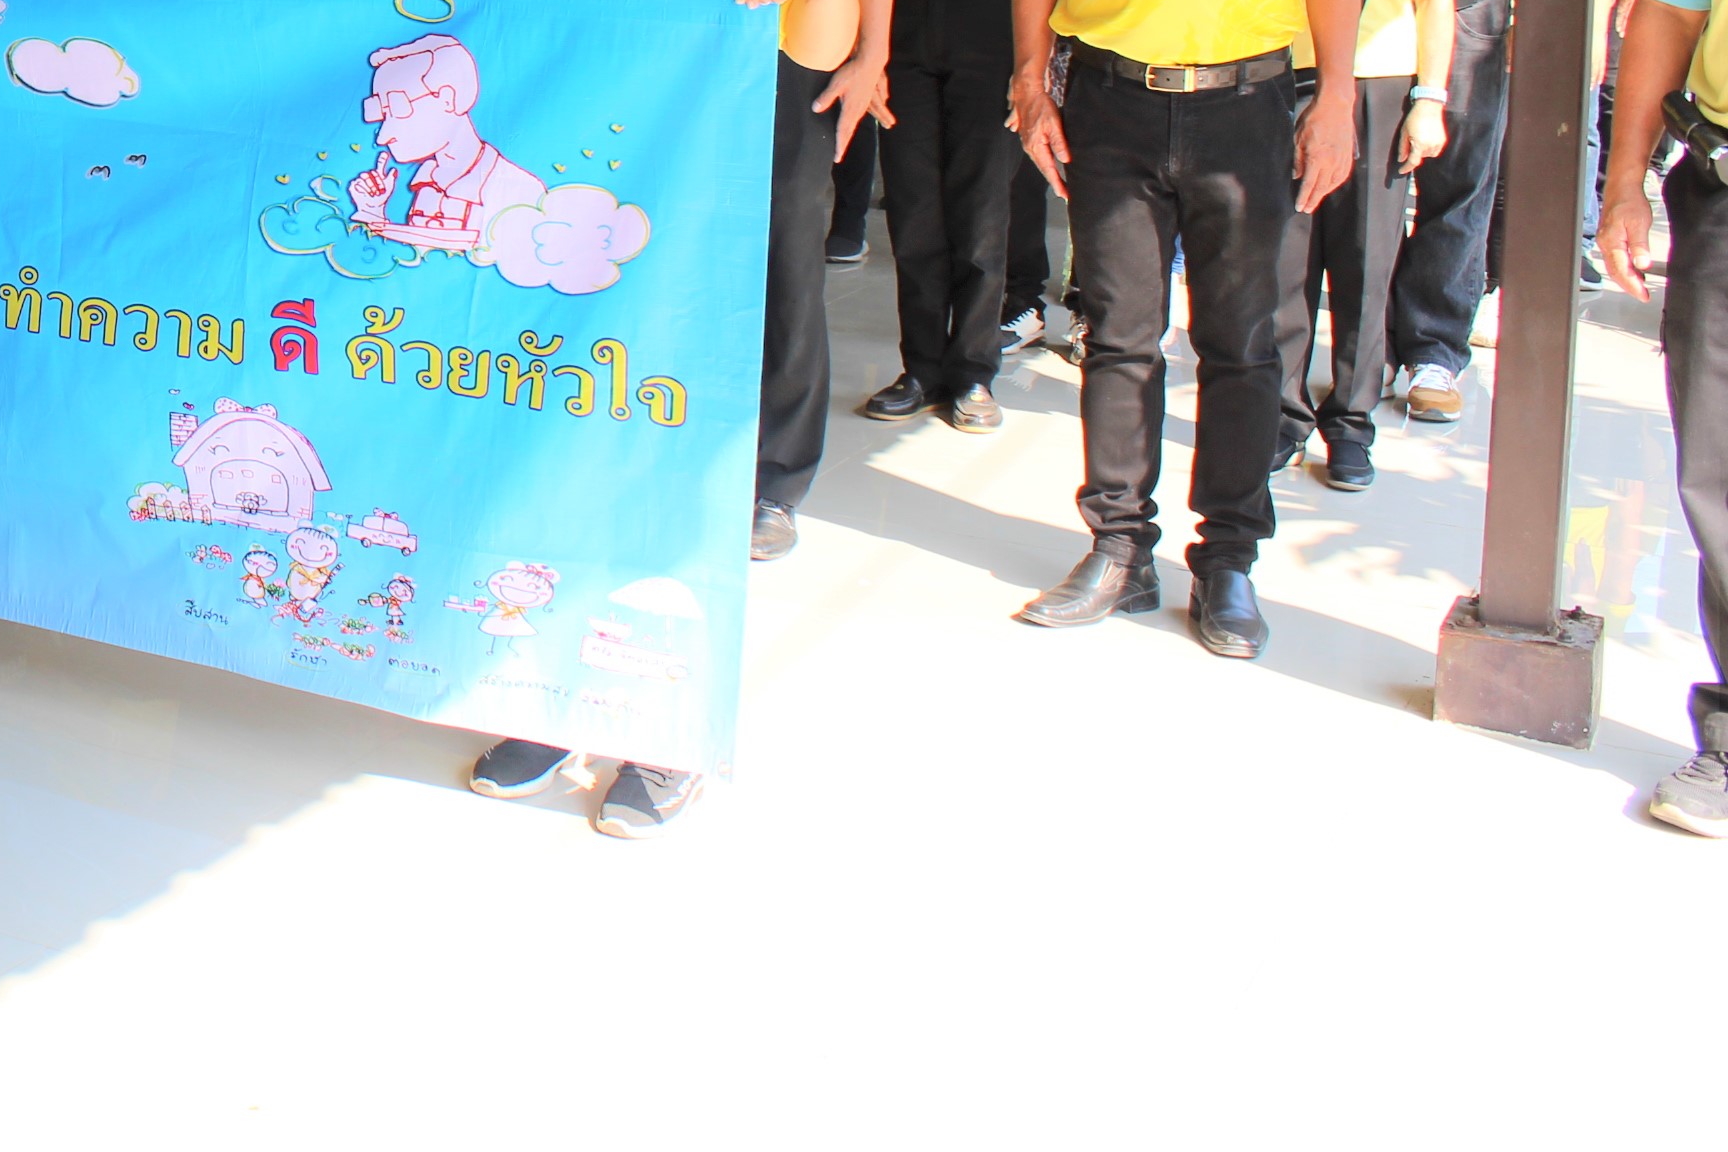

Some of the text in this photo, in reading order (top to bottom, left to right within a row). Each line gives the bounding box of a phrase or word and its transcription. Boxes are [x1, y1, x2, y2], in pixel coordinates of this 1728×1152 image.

[270, 298, 320, 375] ดี
[345, 305, 688, 428] ด้วยหัวใจ
